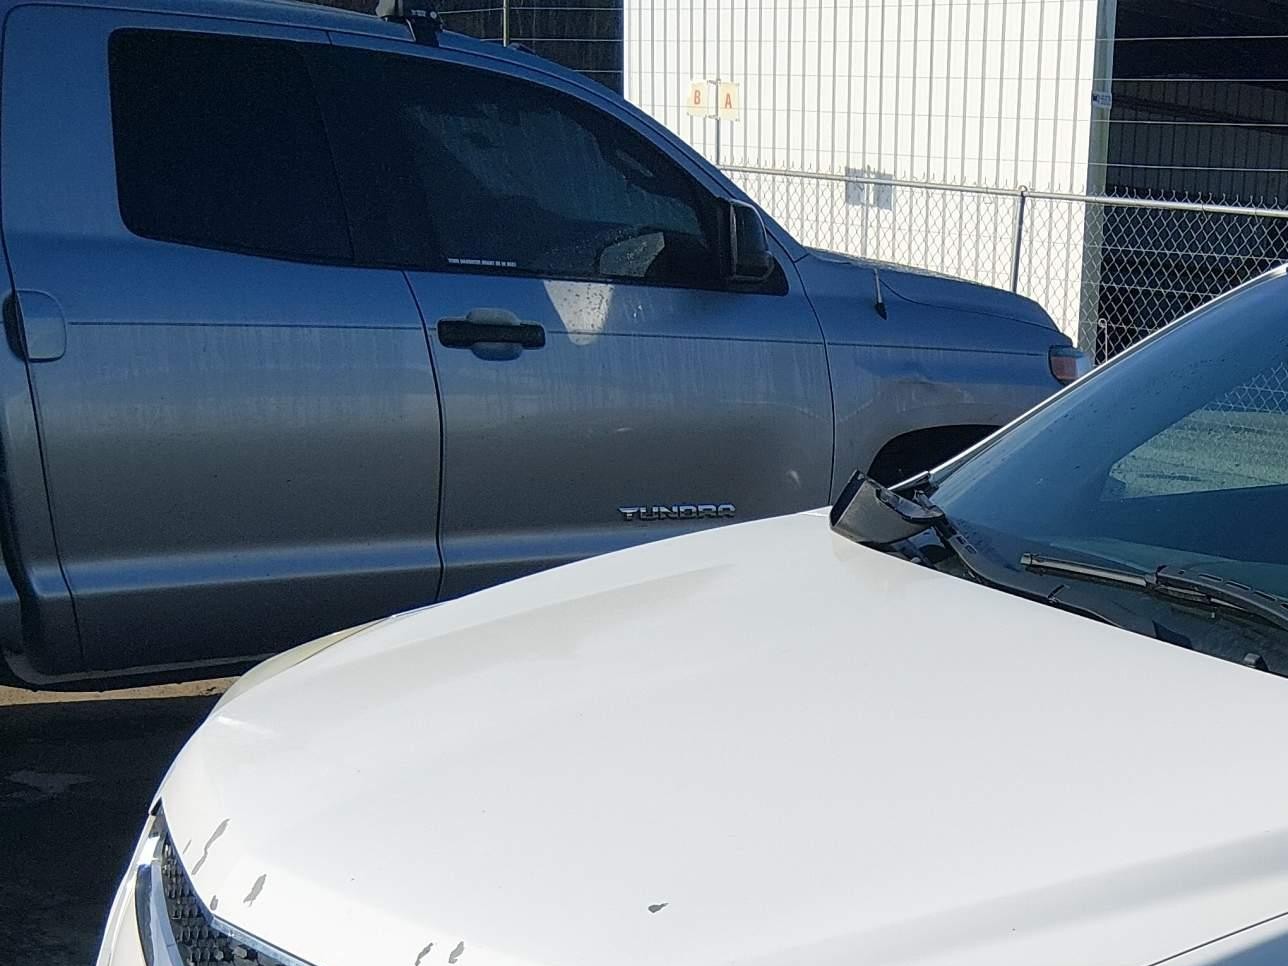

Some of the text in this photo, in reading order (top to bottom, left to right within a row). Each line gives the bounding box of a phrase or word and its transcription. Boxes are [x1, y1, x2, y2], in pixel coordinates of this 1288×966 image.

[694, 90, 701, 105] B
[724, 93, 732, 109] A
[618, 503, 736, 520] TUNDRA
